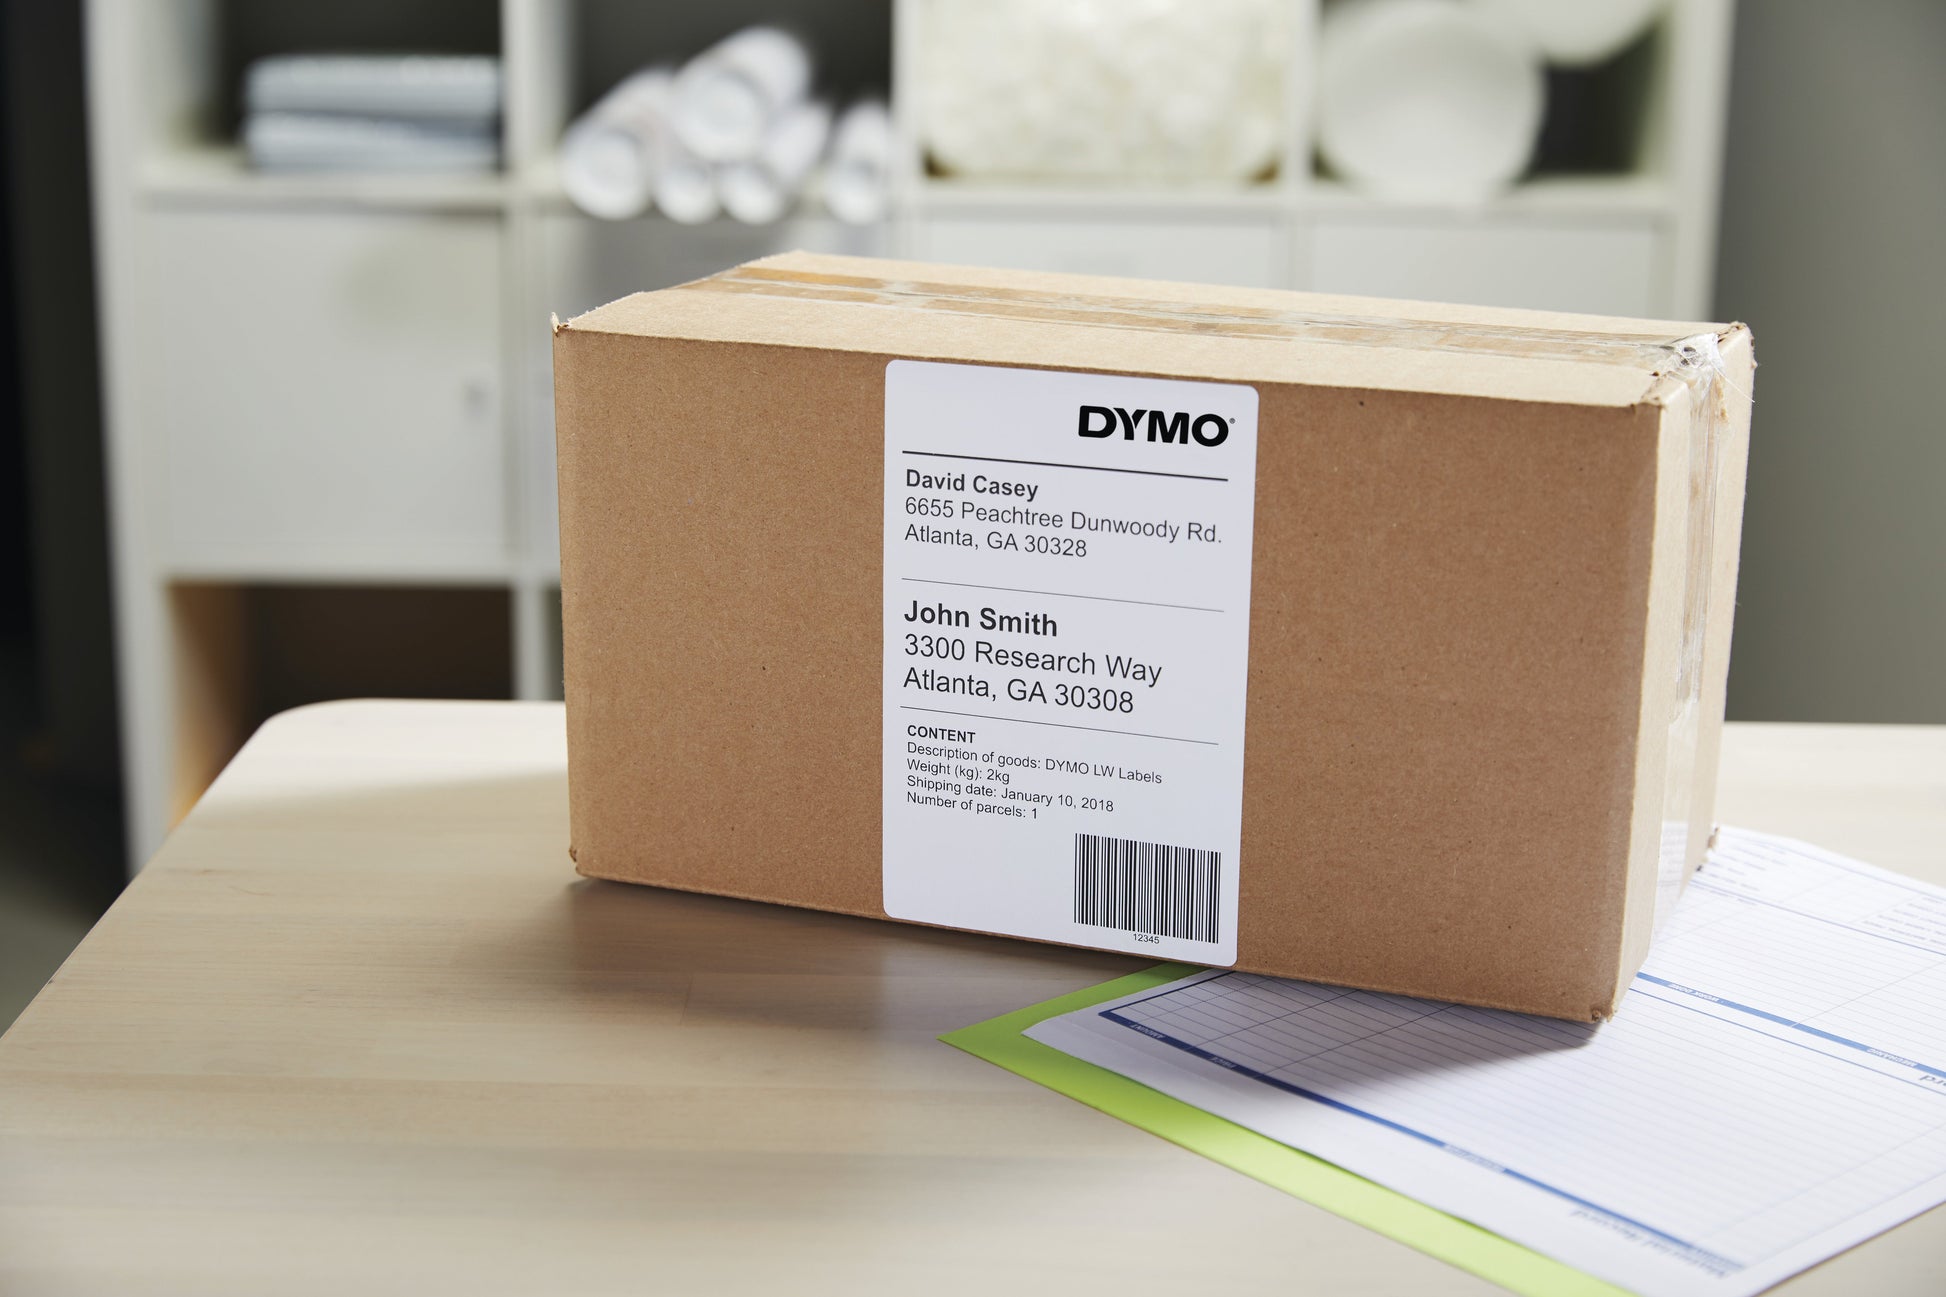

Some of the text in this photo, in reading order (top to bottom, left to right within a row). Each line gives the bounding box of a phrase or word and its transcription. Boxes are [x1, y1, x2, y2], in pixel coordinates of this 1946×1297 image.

[1078, 405, 1229, 447] DYMO
[906, 469, 1039, 502] David Casey
[905, 497, 1222, 543] 6655 Peachtree Dunwoody Rd.
[904, 524, 1087, 557] Atlanta, GA 30328
[904, 600, 1058, 637] John Smith
[904, 634, 1162, 688] 3300 Research Way
[903, 668, 1133, 713] Atlanta, GA 30308
[907, 725, 976, 743] CONTENT
[907, 742, 1162, 784] Description of goods: DYMO LW Labels
[907, 759, 1010, 784] Weight (kg): 2kg
[907, 775, 1114, 812] Shipping date: January 10, 2018
[907, 792, 1038, 819] Number of parcels: 1
[1132, 933, 1160, 944] 12345
[1130, 1022, 1166, 1040] AMOUNT
